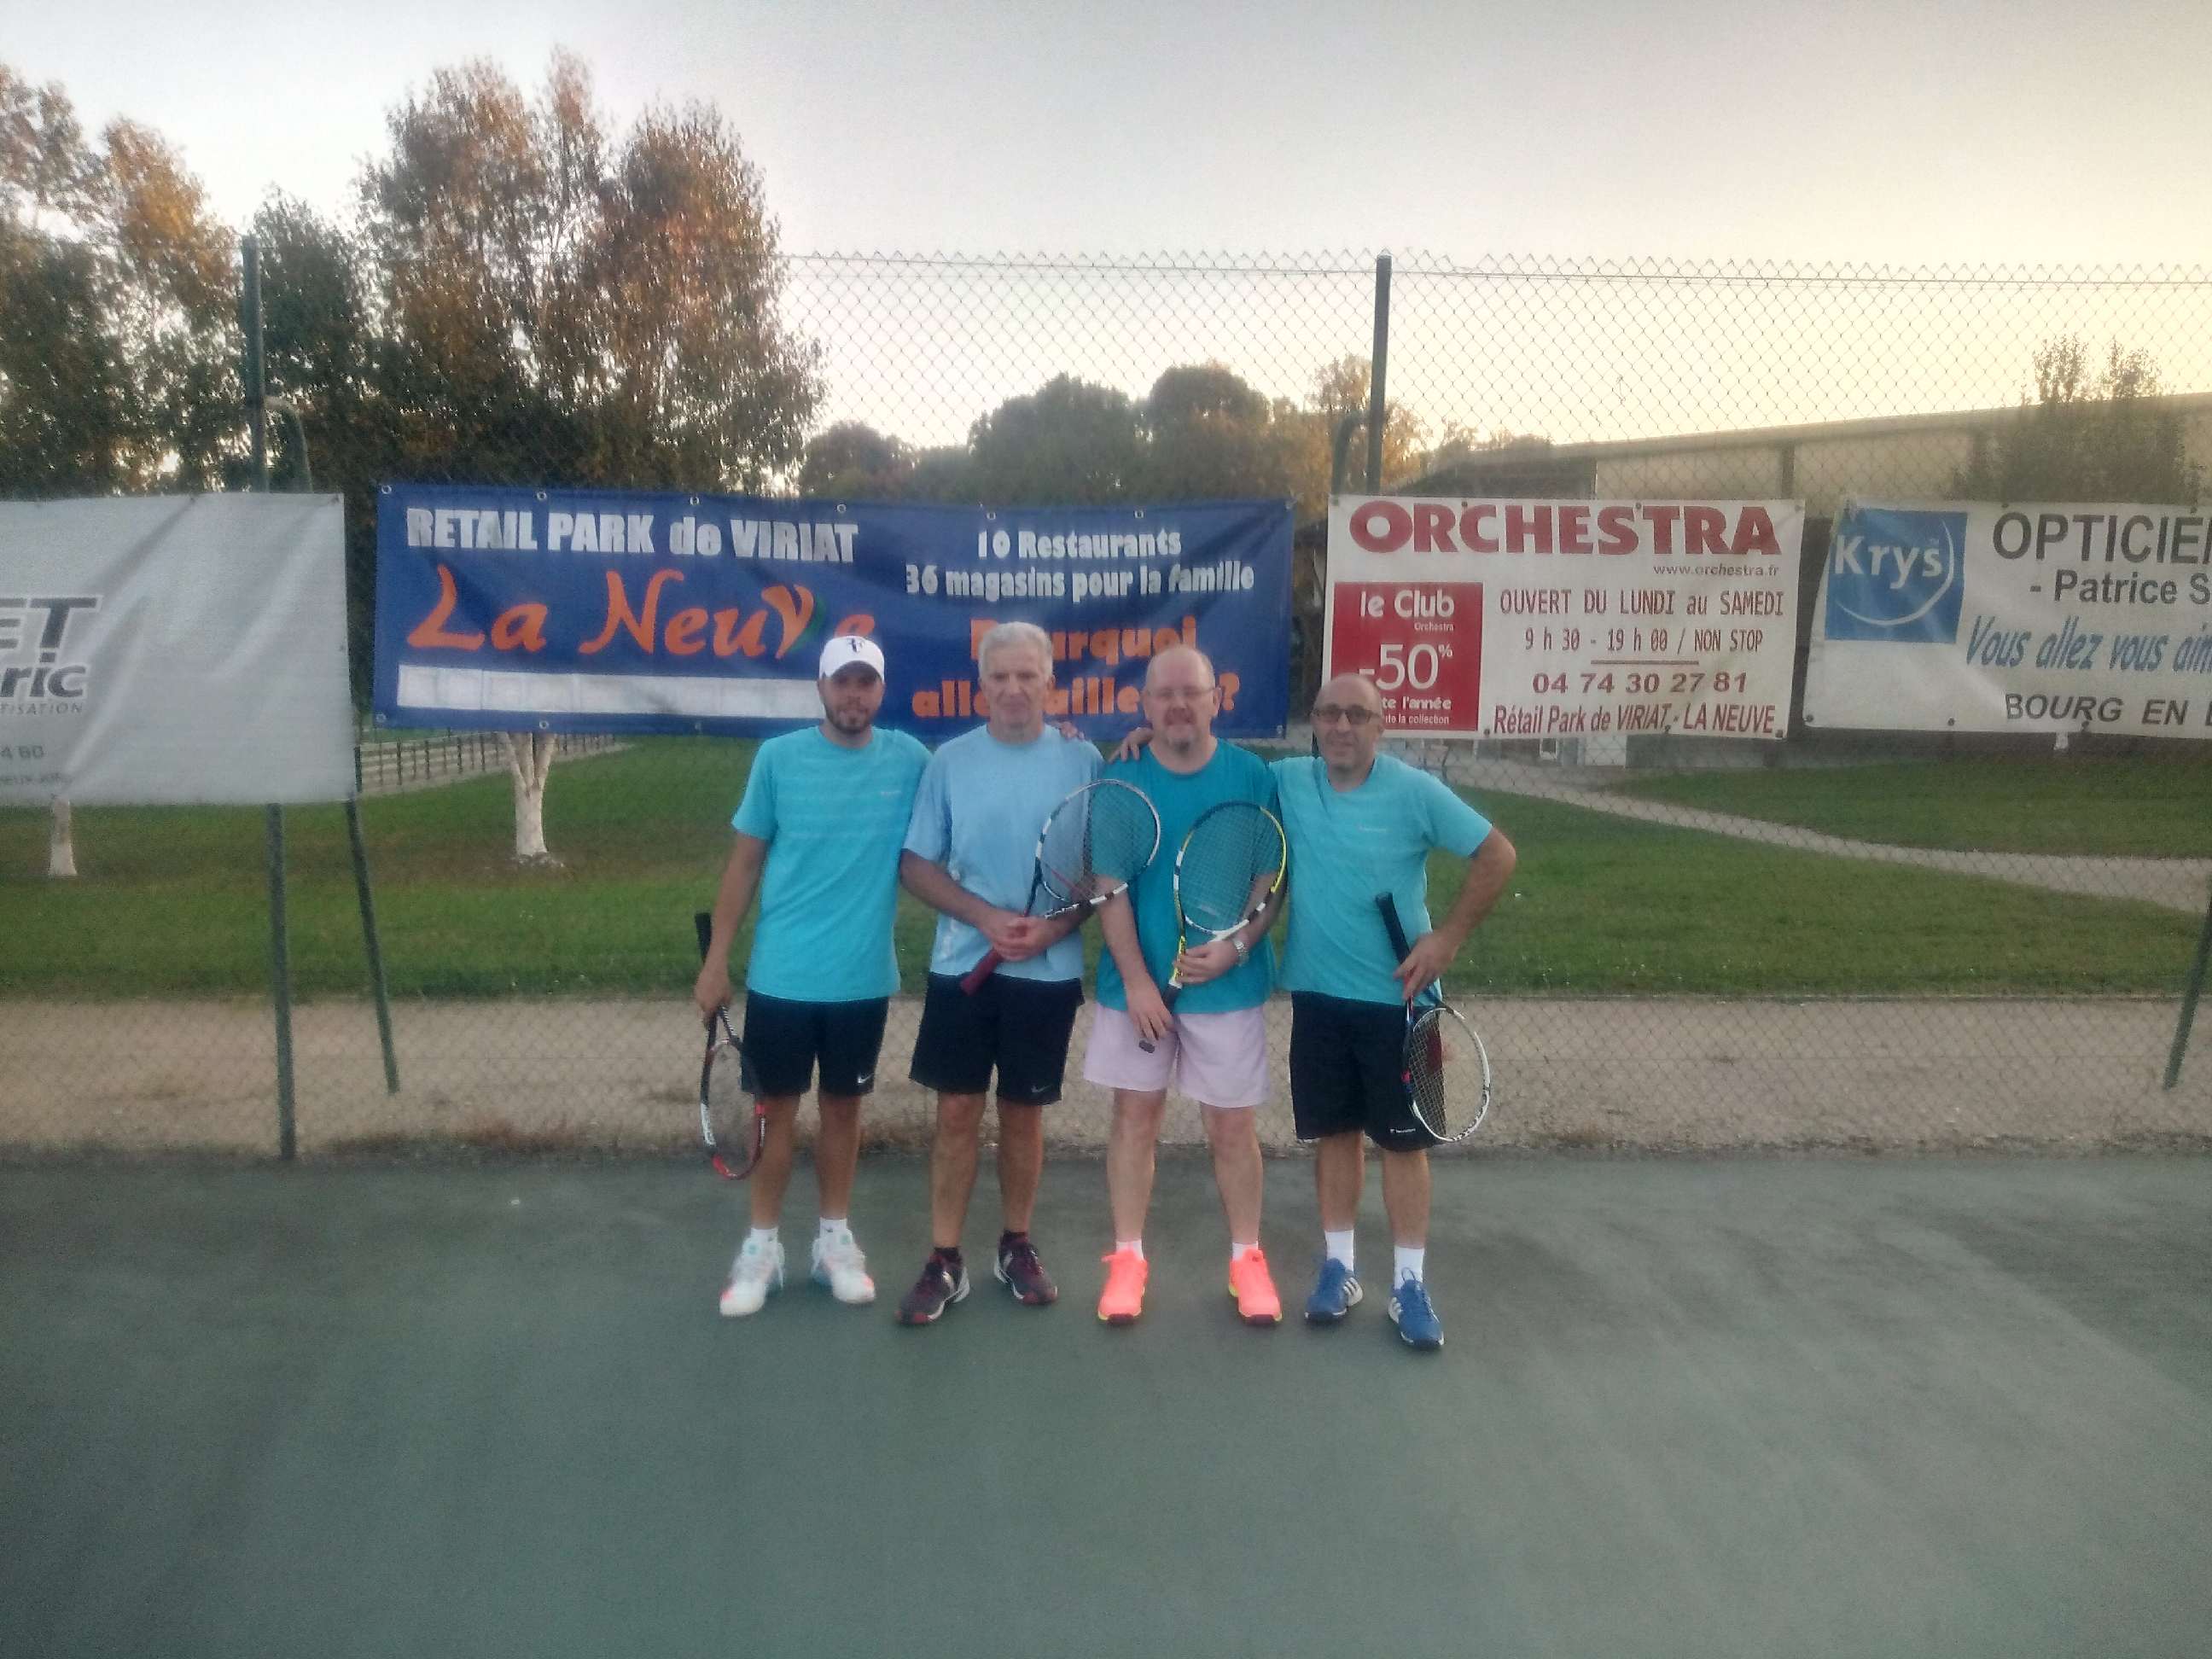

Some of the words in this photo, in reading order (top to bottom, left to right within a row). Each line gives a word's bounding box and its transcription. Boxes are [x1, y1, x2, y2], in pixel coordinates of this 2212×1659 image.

[406, 508, 537, 550] RETAIL
[548, 512, 654, 553] PARK
[669, 516, 721, 555] de
[731, 519, 858, 562] VIRIAT
[1018, 527, 1181, 558] Restaurants
[1349, 501, 1782, 555] ORCHESTRA
[1654, 562, 1778, 576] www.orchestra.fr
[1835, 534, 1942, 589] Krys
[906, 564, 938, 594] 36
[946, 567, 1065, 602] magasins
[1073, 571, 1132, 602] pour
[1140, 565, 1161, 595] la
[1168, 560, 1254, 592] famille
[2055, 569, 2177, 604] Patrice
[407, 564, 548, 651] La
[1360, 591, 1384, 618] le
[1394, 590, 1454, 618] Club
[1500, 589, 1571, 614] OUVERT
[1584, 590, 1606, 614] DU
[1620, 590, 1674, 614] LUNDI
[1686, 596, 1707, 615] au
[1720, 591, 1784, 615] SAMEDI
[1544, 627, 1551, 649] h
[1562, 628, 1580, 650] 30
[1608, 628, 1624, 651] 19
[1633, 628, 1641, 651] h
[1650, 628, 1668, 651] 00
[1694, 629, 1720, 651] NON
[1730, 629, 1763, 652] STOP
[1966, 615, 2031, 667] Vous
[2036, 615, 2103, 670] allez
[2110, 635, 2168, 671] vous
[1533, 672, 1568, 693] 04
[1580, 672, 1615, 693] 74
[1626, 672, 1660, 694] 30
[1670, 672, 1705, 693] 27
[1714, 672, 1747, 693] 81
[1402, 696, 1452, 710] l'année
[1409, 713, 1449, 724] collection
[1494, 705, 1543, 734] Rétail
[1548, 705, 1585, 733] Park
[1591, 705, 1610, 731] de
[1683, 702, 1707, 730] LA
[1713, 703, 1775, 733] NEUVE
[2005, 694, 2123, 722] BOURG
[2141, 699, 2187, 725] EN
